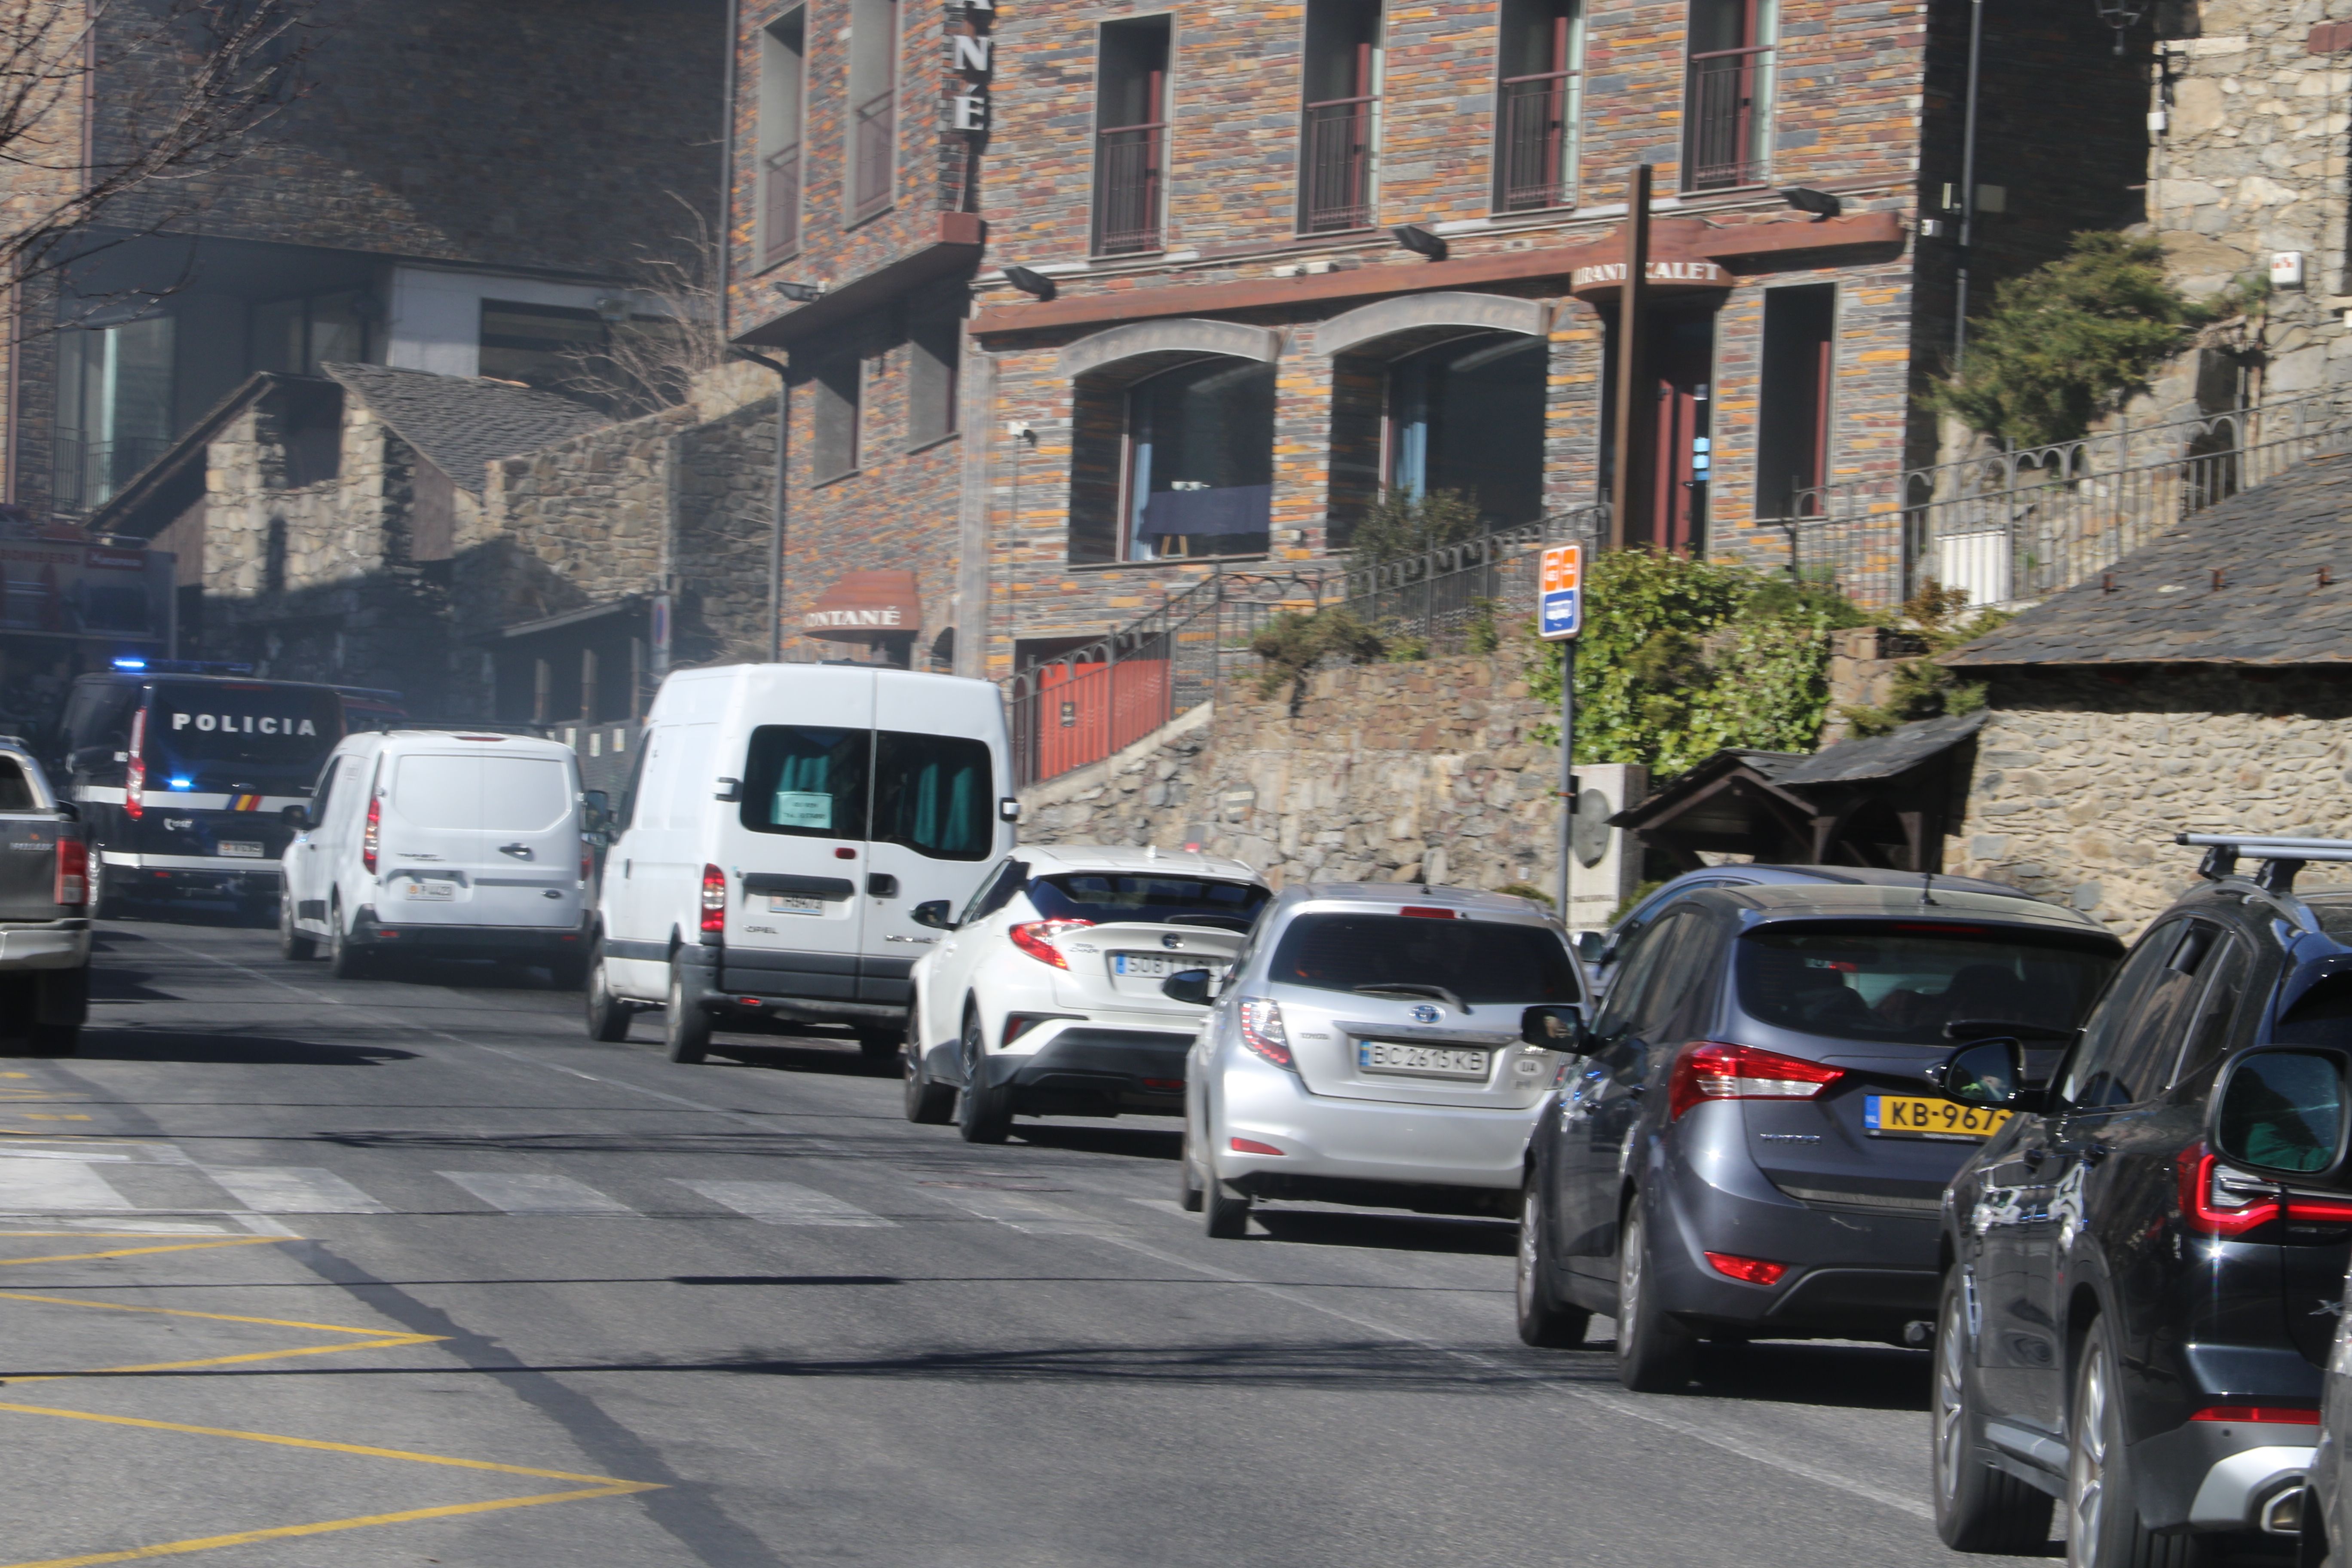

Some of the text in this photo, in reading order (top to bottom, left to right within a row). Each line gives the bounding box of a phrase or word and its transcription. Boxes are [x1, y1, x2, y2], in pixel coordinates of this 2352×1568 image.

[952, 0, 990, 130] NÉ
[803, 606, 900, 628] ONTANÉ
[172, 713, 317, 736] POLICIA
